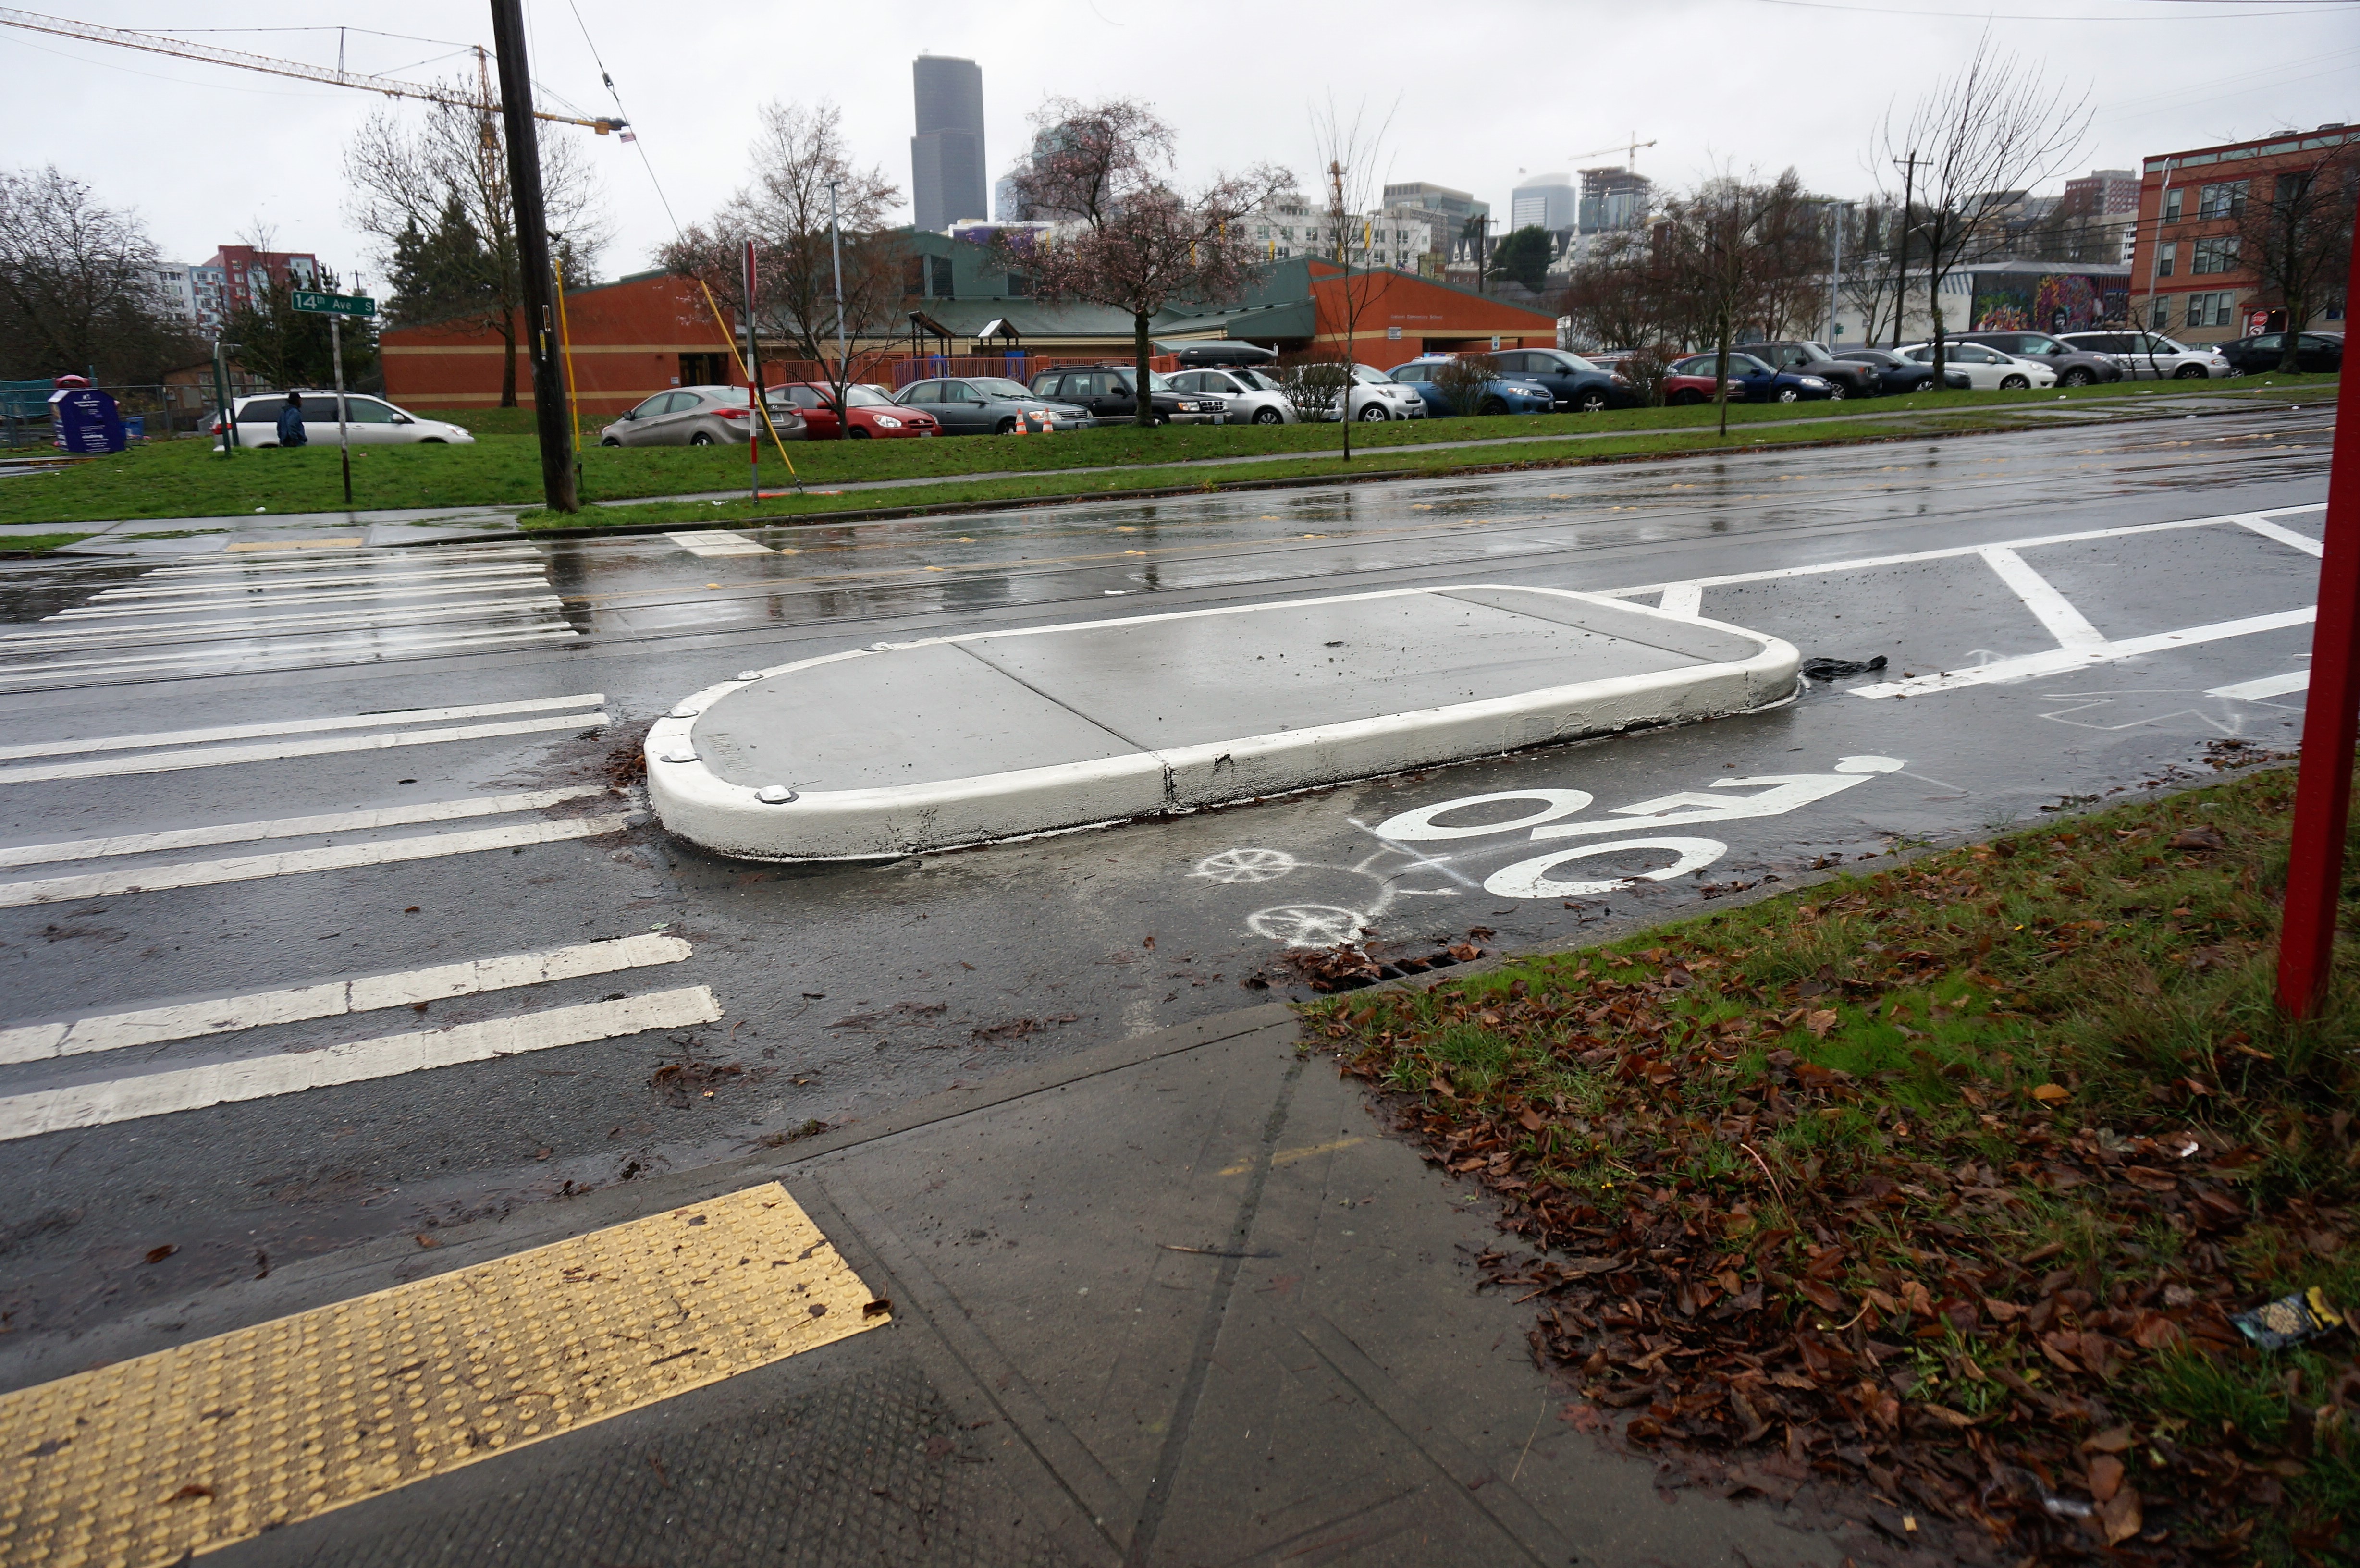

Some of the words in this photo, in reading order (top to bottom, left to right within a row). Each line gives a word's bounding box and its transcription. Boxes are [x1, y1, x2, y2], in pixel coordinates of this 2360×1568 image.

[295, 294, 325, 309] 14th
[332, 299, 352, 310] Ave
[365, 302, 372, 311] S
